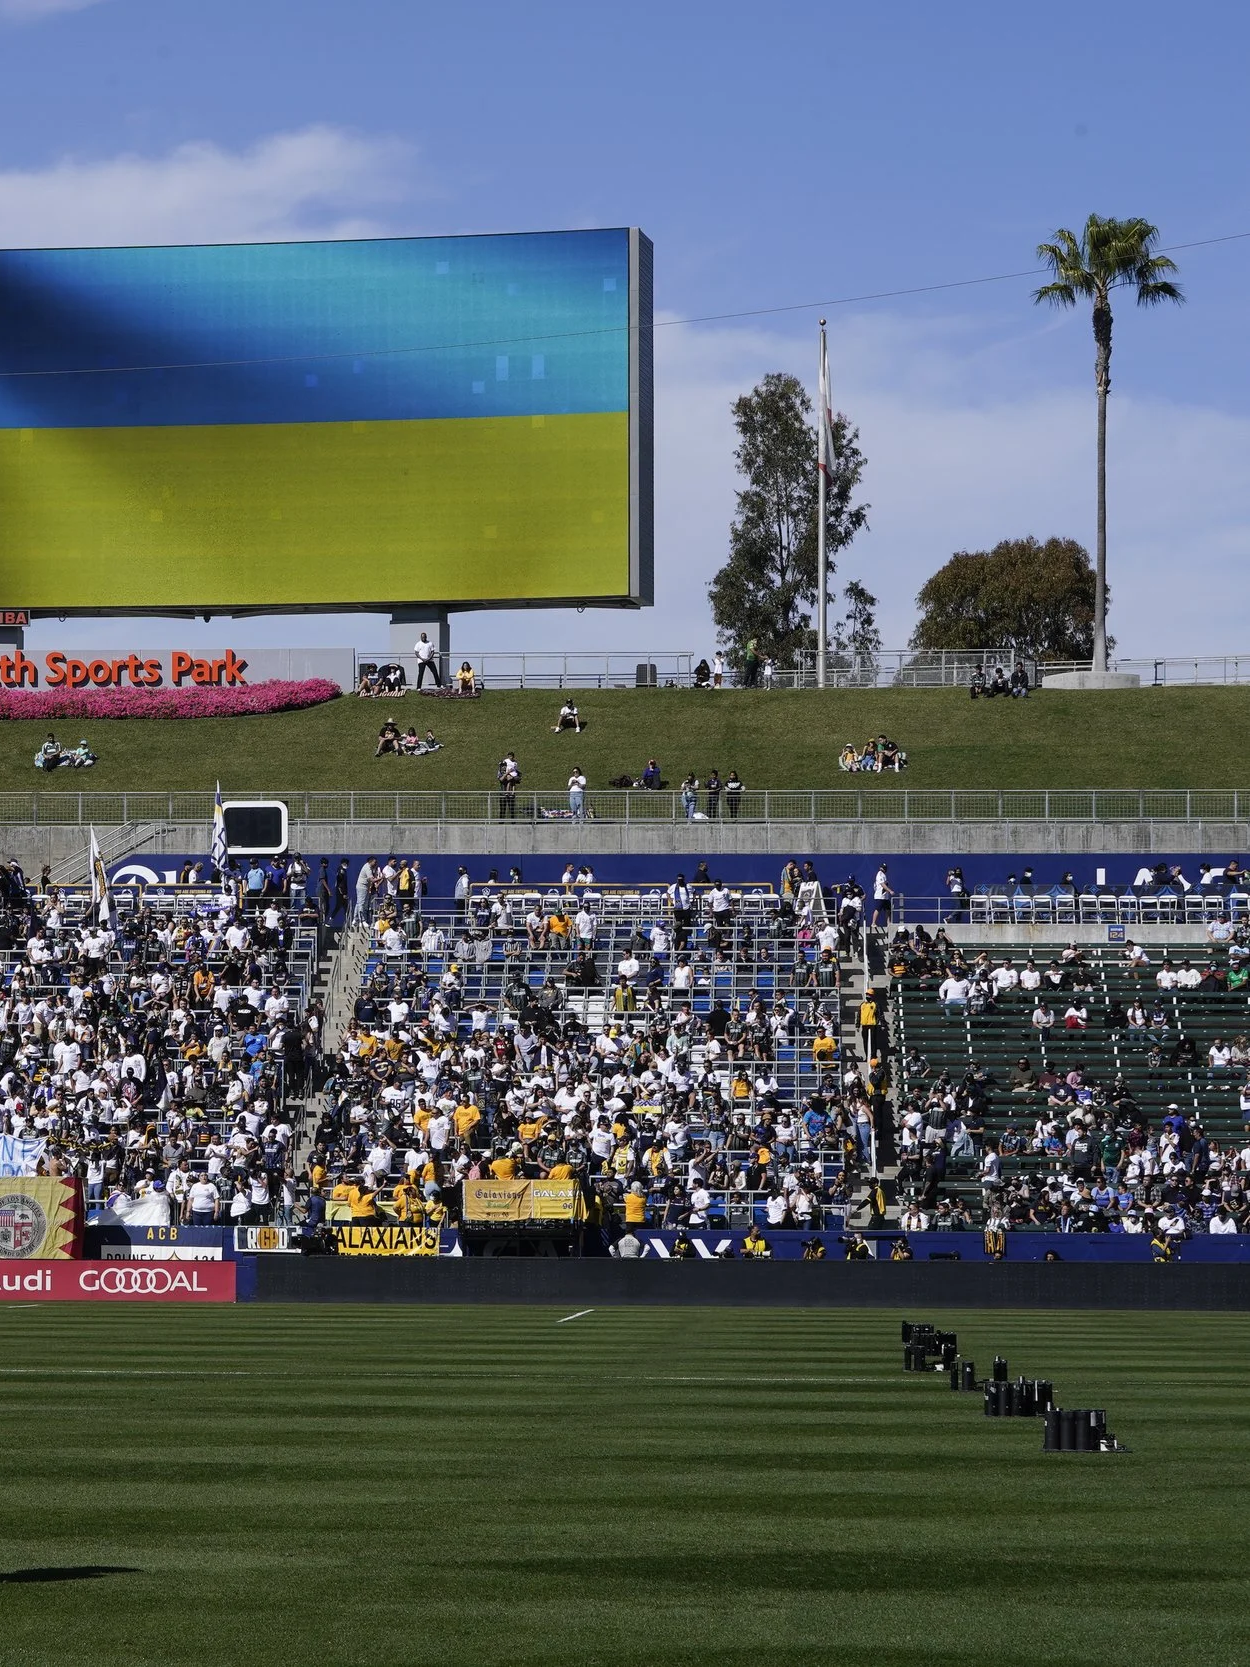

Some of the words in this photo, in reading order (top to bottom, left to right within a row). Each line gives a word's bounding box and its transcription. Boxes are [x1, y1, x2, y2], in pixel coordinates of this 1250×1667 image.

[45, 651, 162, 688] Sports
[172, 648, 247, 686] Park
[336, 1227, 436, 1249] ALAXIANS
[79, 1267, 208, 1294] GOOOOAL
